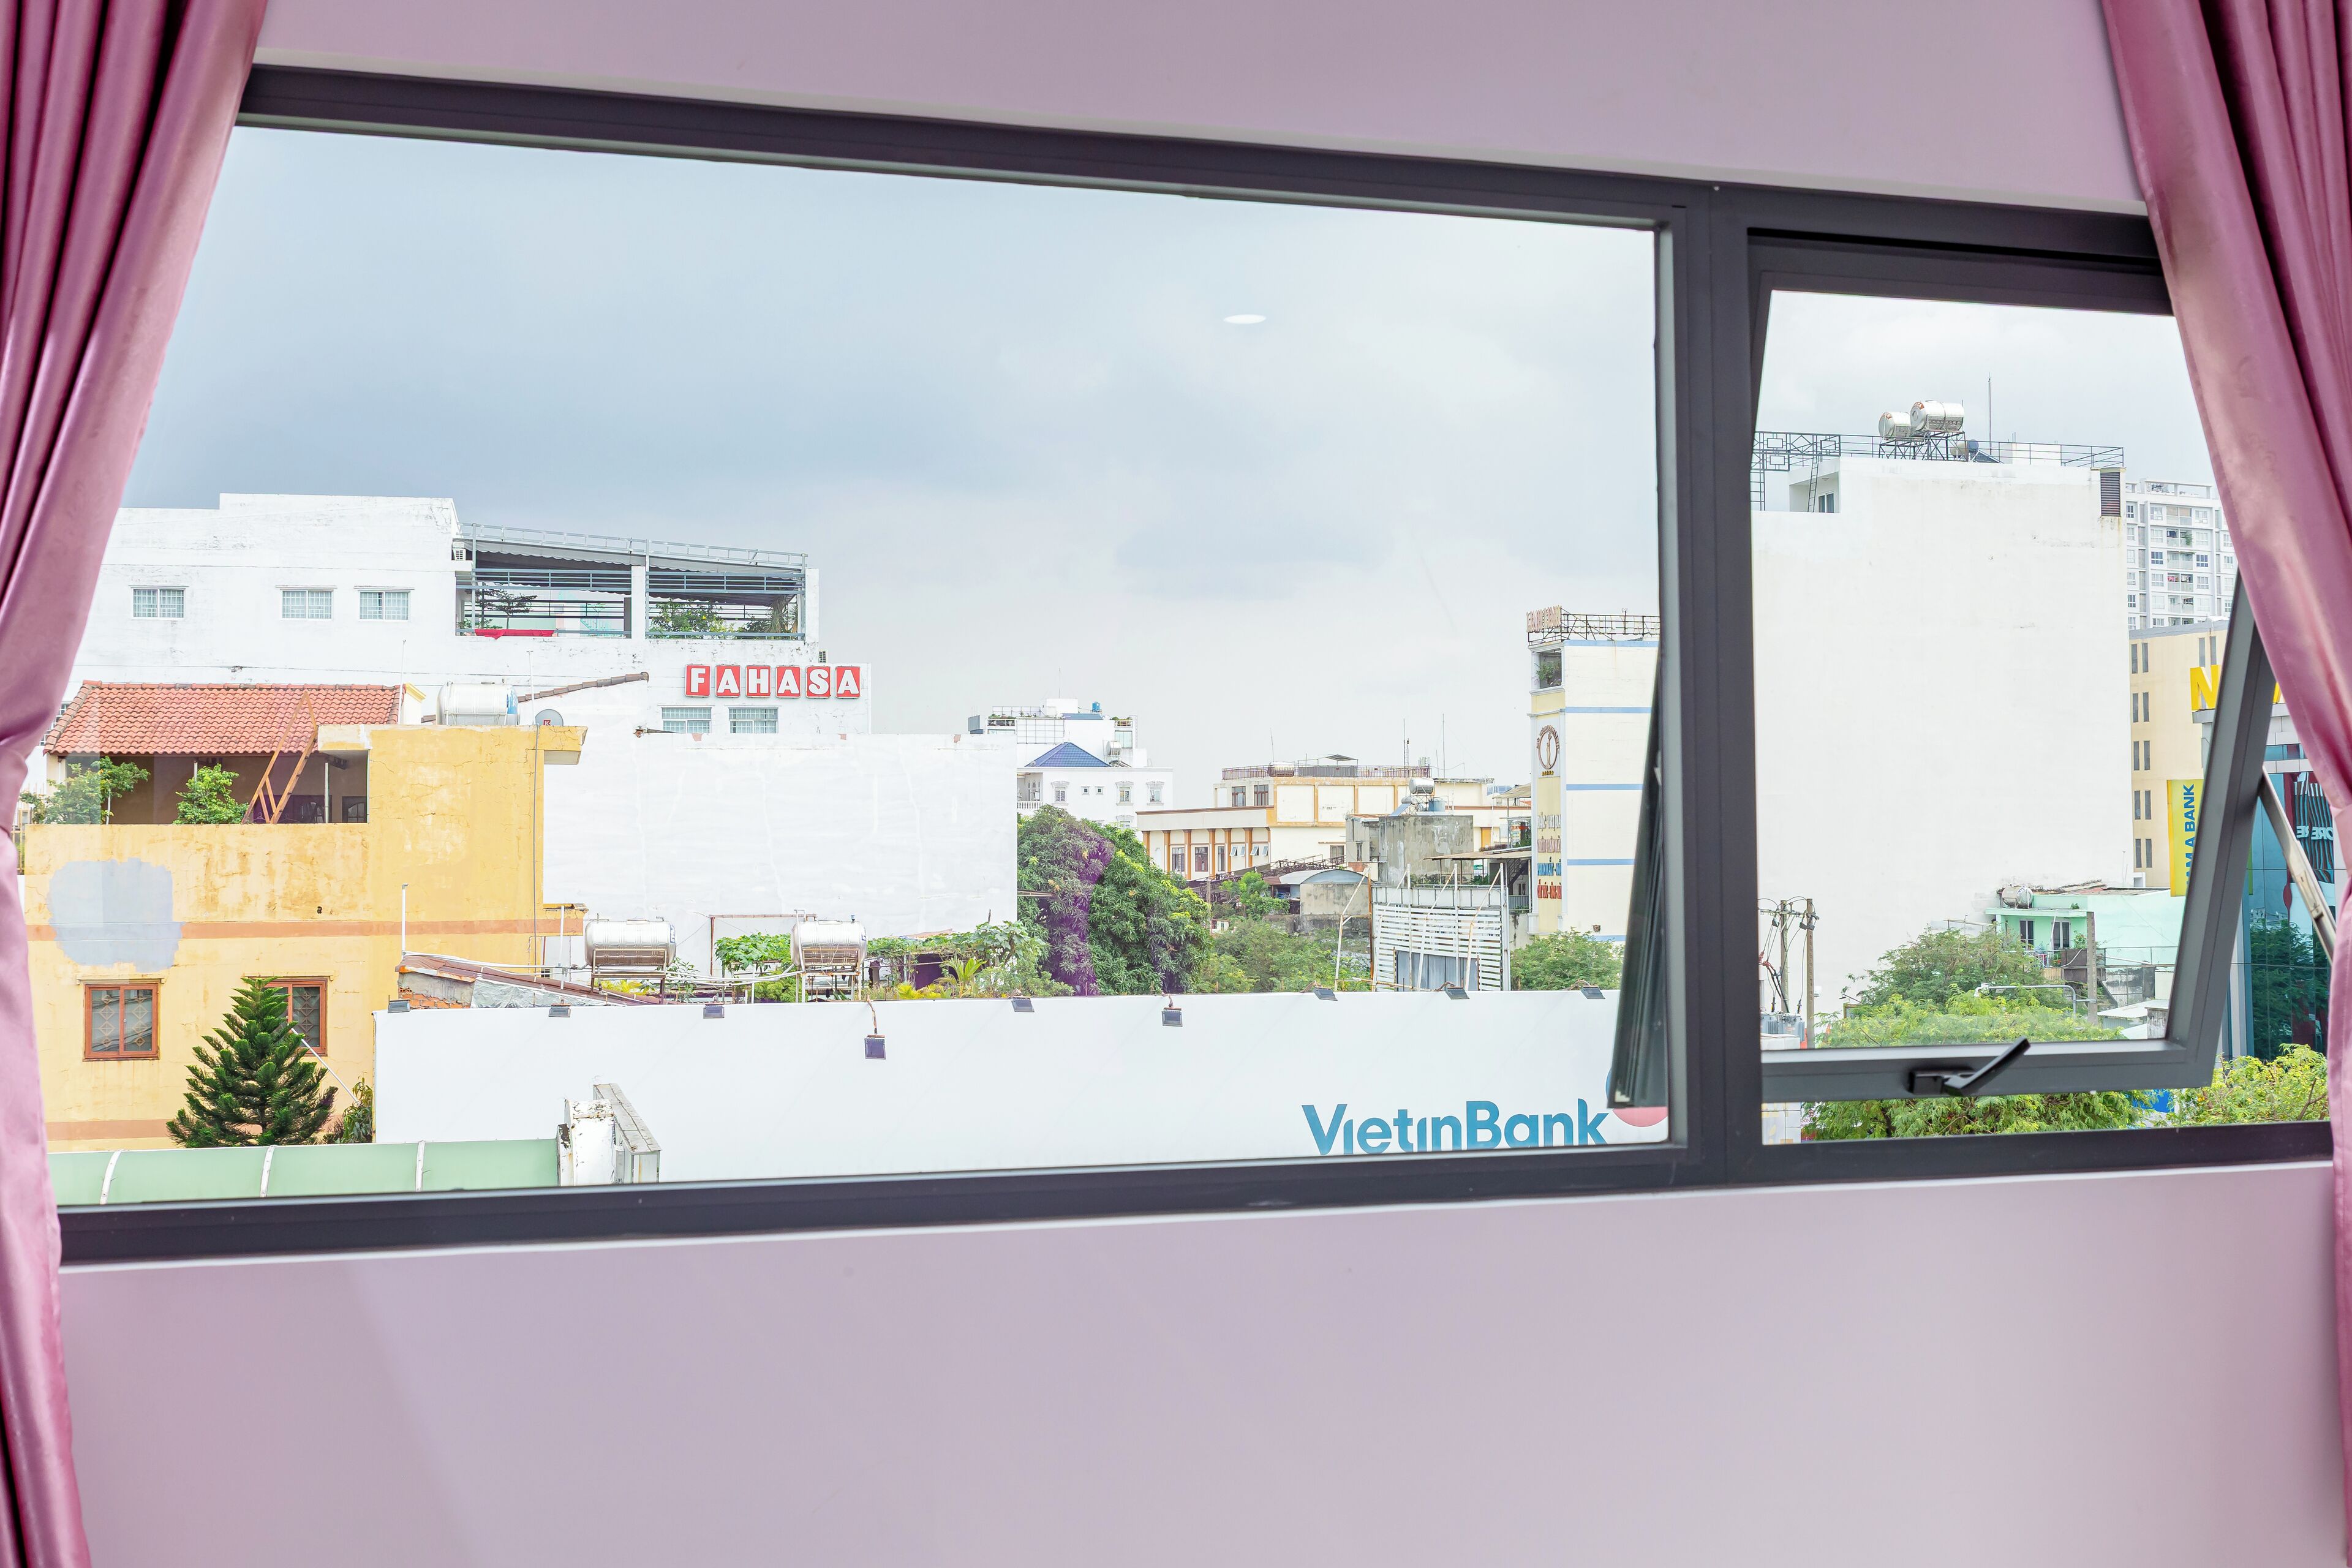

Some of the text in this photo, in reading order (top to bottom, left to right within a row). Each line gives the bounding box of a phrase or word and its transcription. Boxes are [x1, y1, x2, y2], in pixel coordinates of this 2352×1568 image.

[690, 667, 859, 695] FAHASA
[2183, 783, 2196, 832] BANK
[1302, 1098, 1609, 1155] VietinBank
